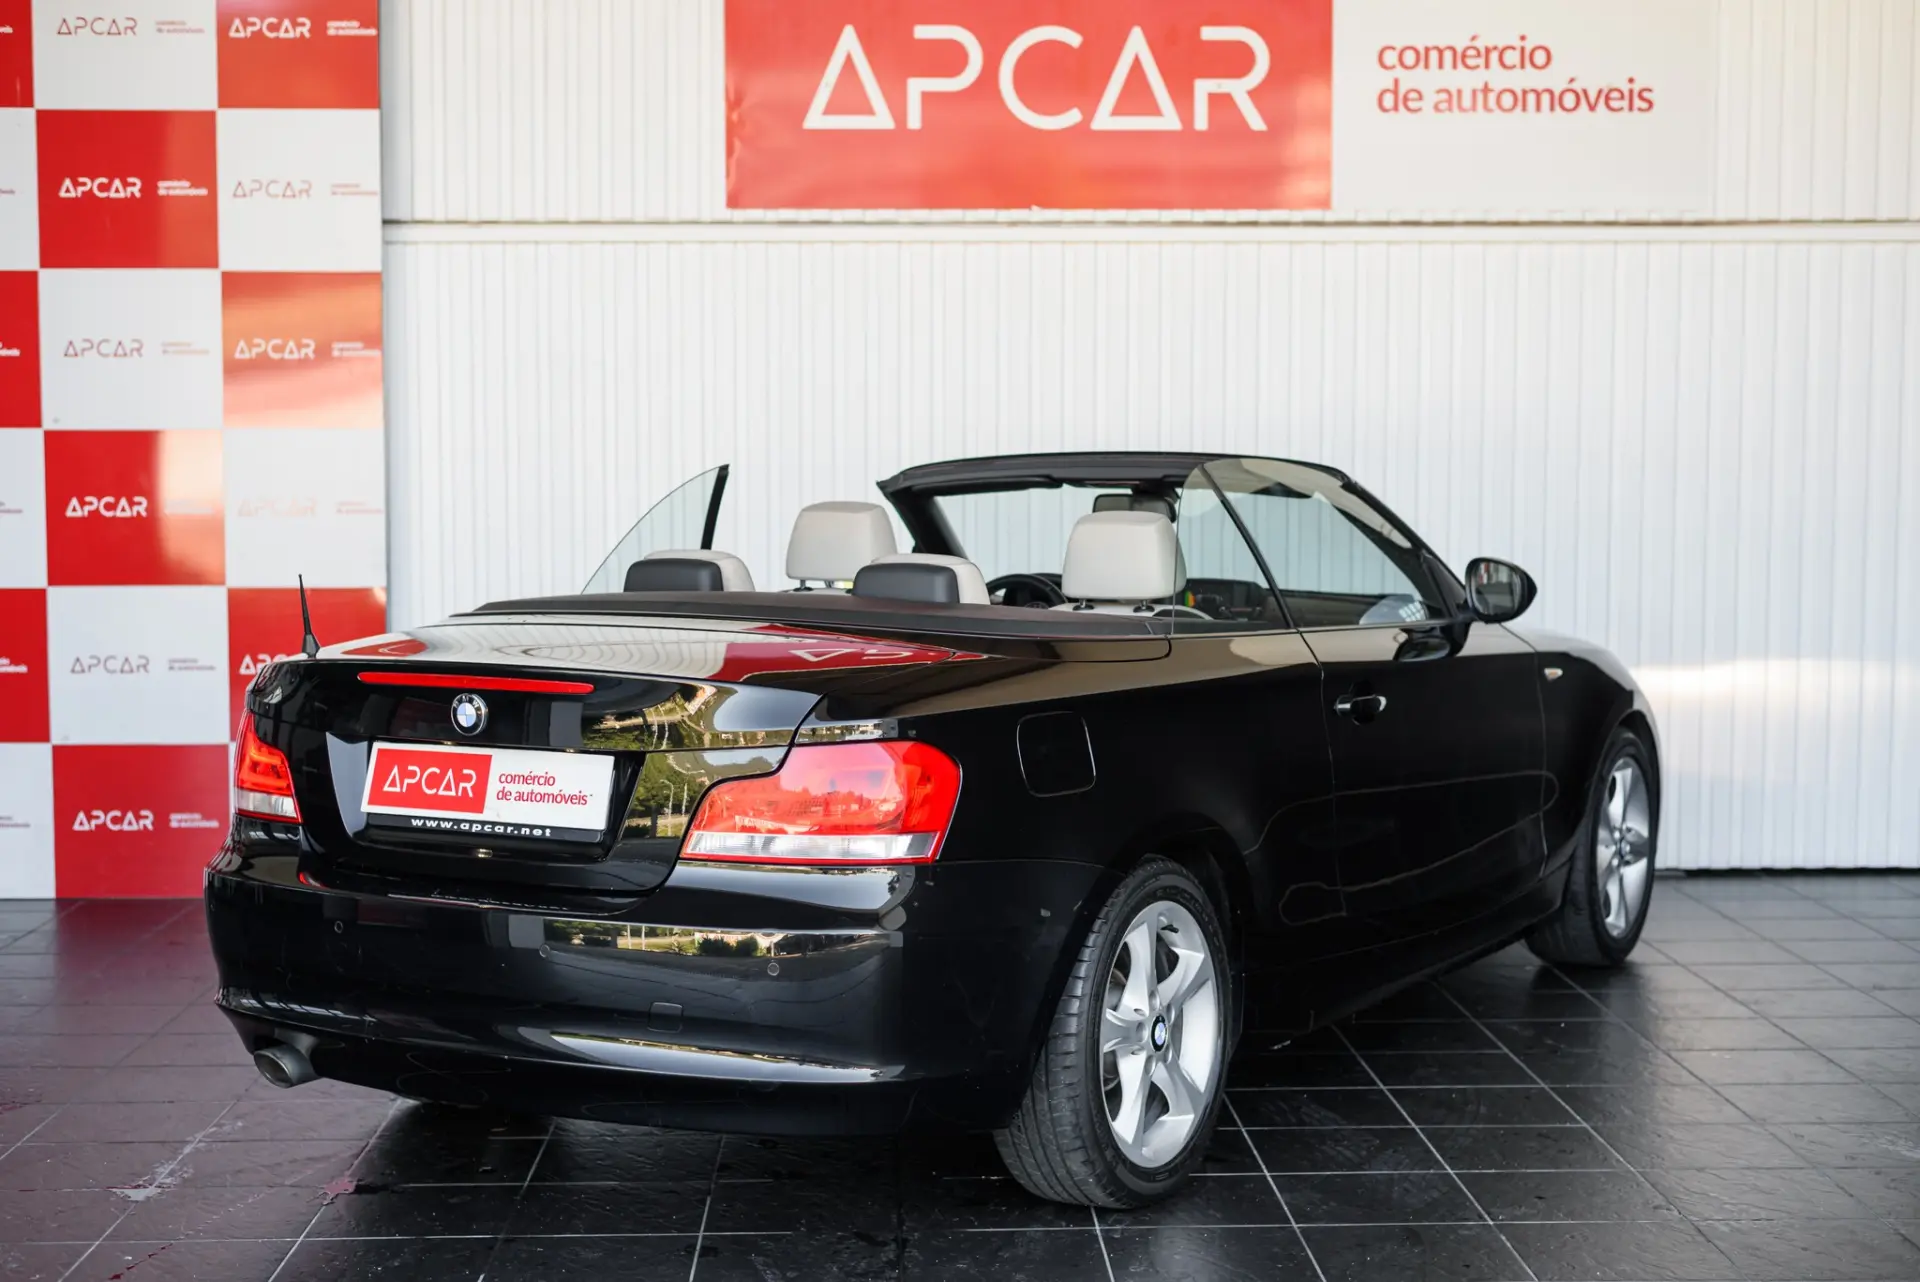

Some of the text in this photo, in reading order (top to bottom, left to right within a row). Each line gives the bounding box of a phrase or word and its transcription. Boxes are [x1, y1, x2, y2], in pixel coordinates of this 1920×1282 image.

[58, 17, 138, 36] APCAR
[229, 17, 311, 39] APCAR
[1378, 35, 1552, 70] comércio
[802, 25, 1270, 132] APCAR
[1377, 77, 1654, 114] de automóveis
[58, 177, 142, 199] APCAR
[232, 180, 313, 199] APCAR
[63, 339, 144, 358] APCAR
[234, 338, 316, 360] APCAR
[65, 496, 148, 518] APCAR
[70, 654, 150, 675] APCAR
[382, 764, 477, 798] APCAR
[498, 771, 556, 787] comércio
[496, 786, 588, 806] de automóveis
[72, 809, 154, 831] APCAR
[411, 817, 552, 838] www.apcar.net
